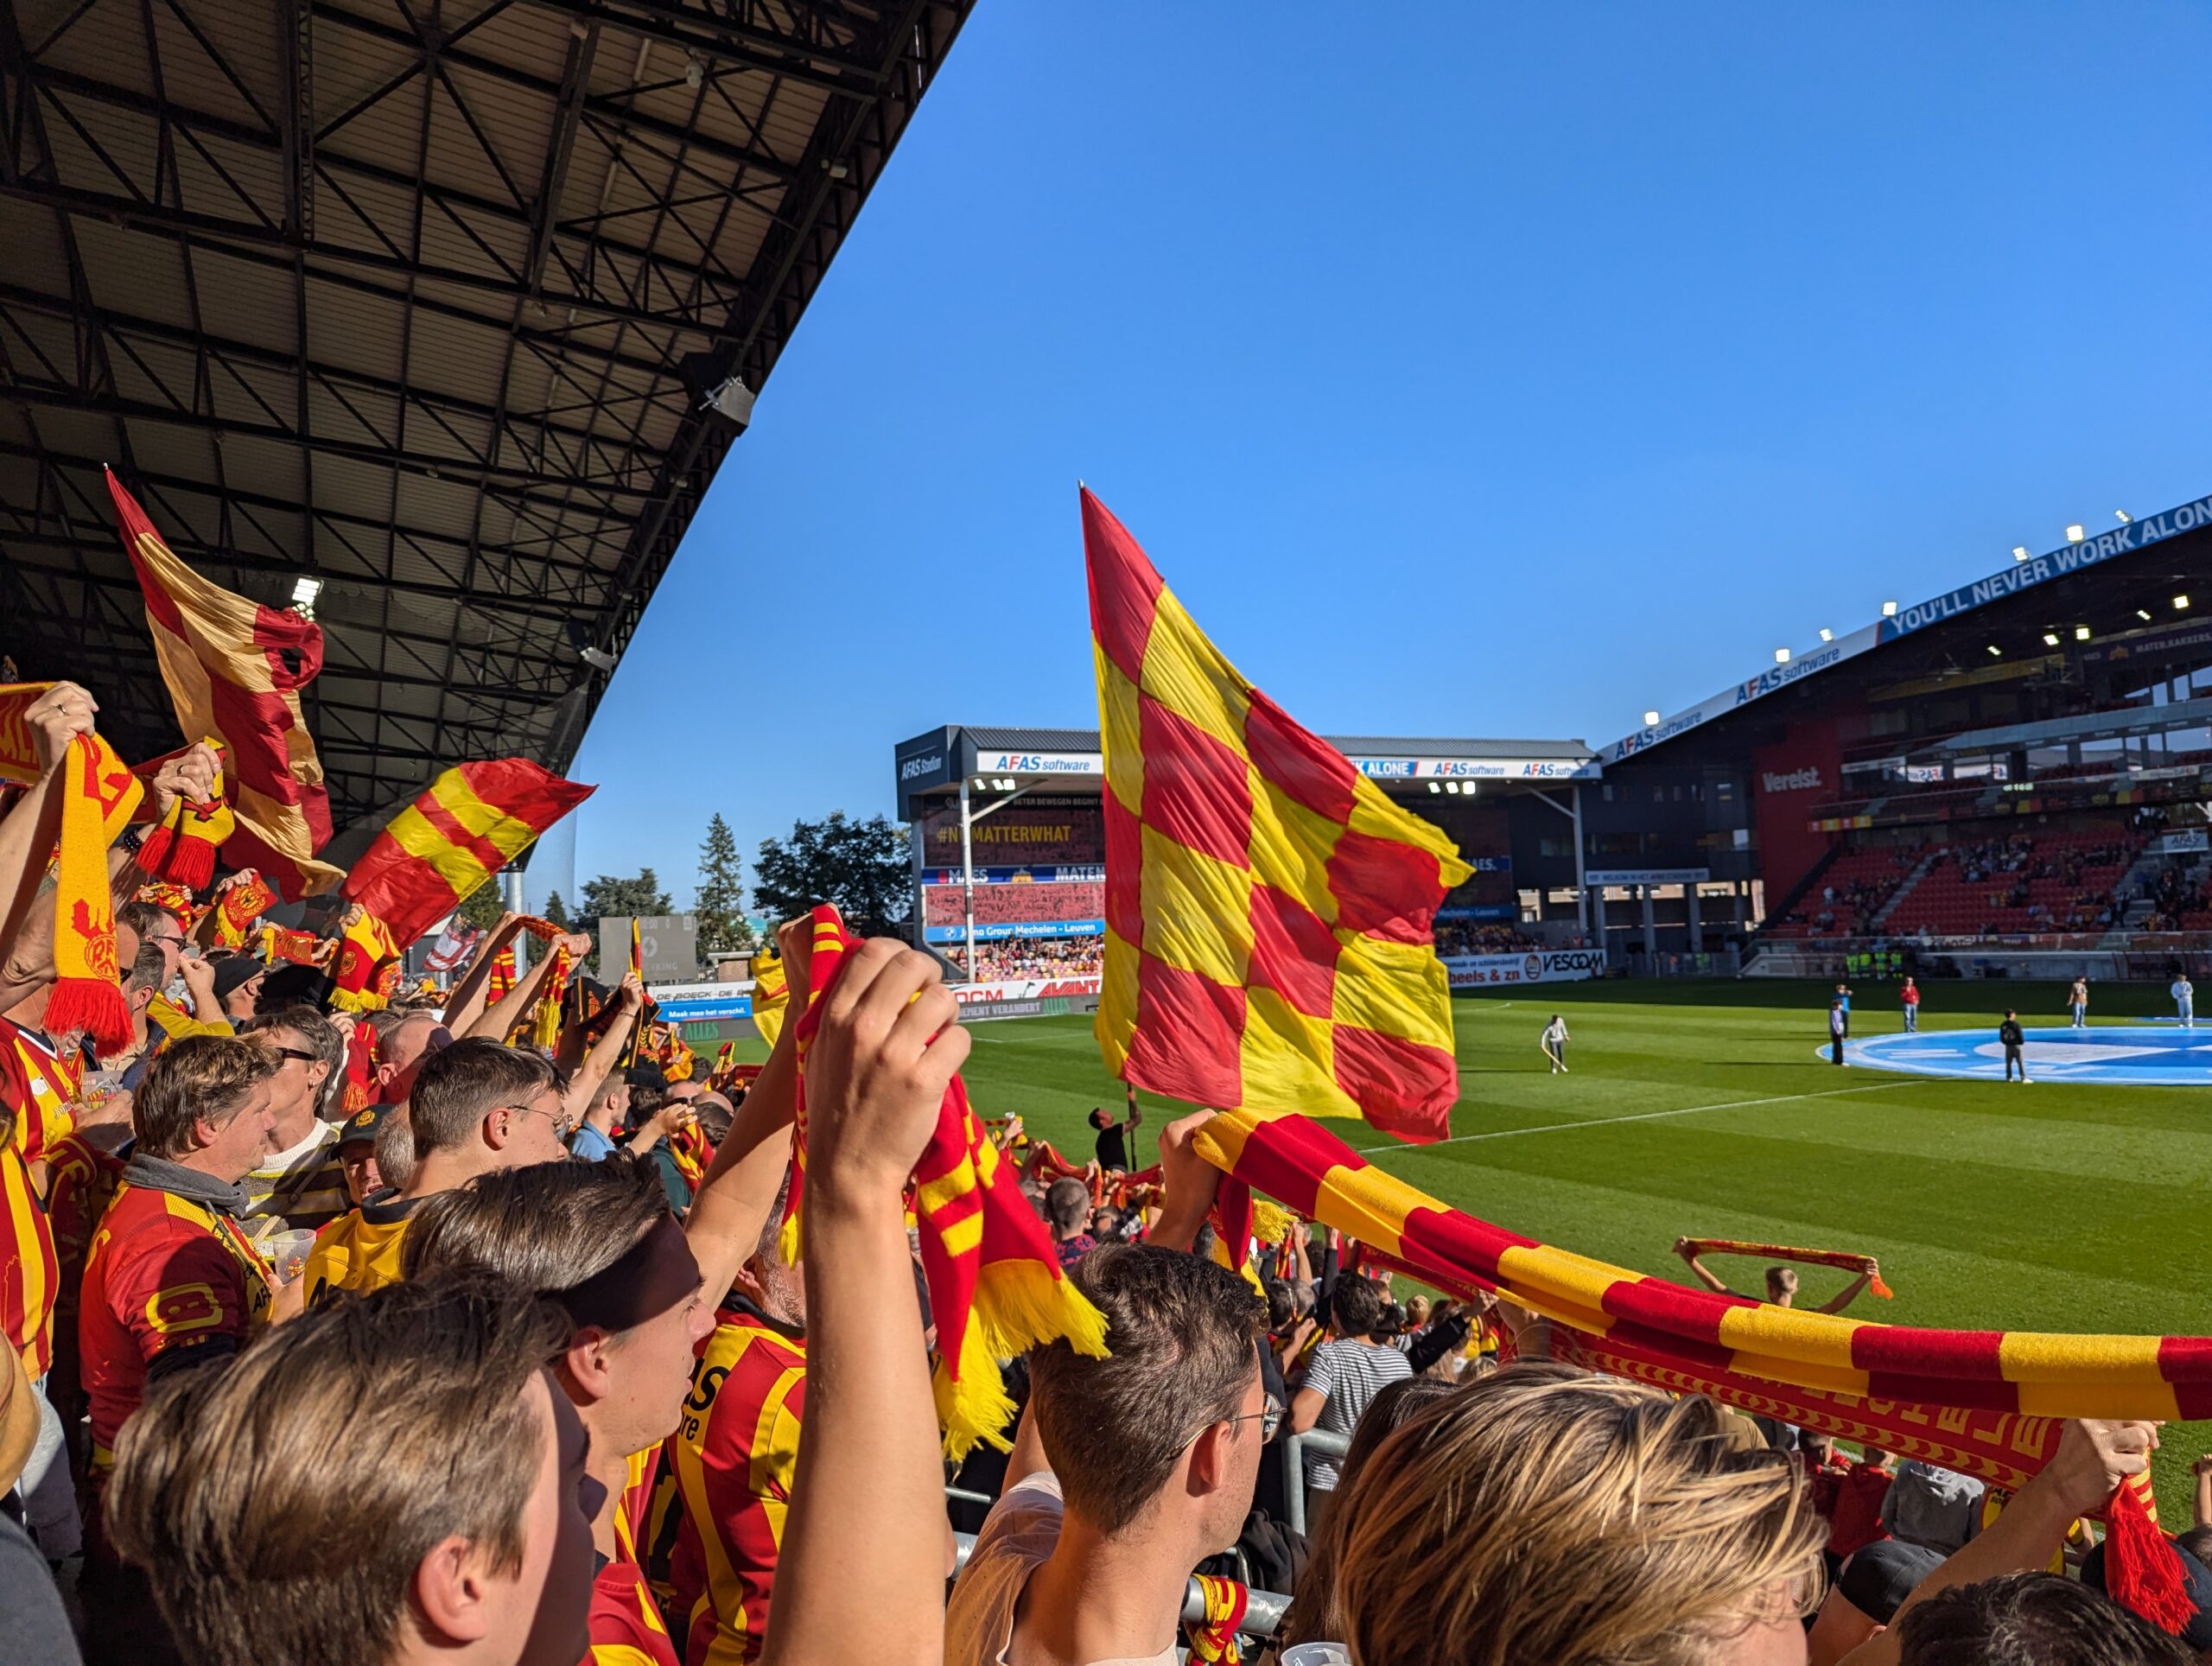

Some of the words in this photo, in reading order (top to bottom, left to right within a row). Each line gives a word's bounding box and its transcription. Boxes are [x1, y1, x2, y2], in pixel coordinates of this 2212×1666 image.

[1891, 593, 1968, 634] YOU'LL
[1972, 559, 2050, 604] NEVER
[2054, 527, 2134, 571] WORK
[1735, 667, 1782, 704] AFAS
[1783, 648, 1840, 682] software
[1616, 728, 1653, 760] AFAS
[1656, 711, 1701, 741] software
[901, 760, 920, 780] AFAS
[921, 756, 942, 774] Stadion
[996, 755, 1041, 771] AFAS
[1042, 760, 1090, 772] software
[1367, 761, 1410, 775] ALONE
[1433, 762, 1467, 776] AFAS
[1468, 765, 1504, 776] software
[1522, 763, 1554, 776] AFAS
[938, 825, 1071, 843] #NMATTERWHAT
[1015, 925, 1057, 935] Mechelen
[1065, 924, 1096, 932] Leuven
[1542, 952, 1604, 972] VESCOM
[1490, 969, 1500, 982] &
[1504, 970, 1520, 982] zn
[676, 991, 712, 1000] BOECK
[669, 1009, 688, 1018] Maak
[993, 1002, 1040, 1014] VERANDERT
[1043, 997, 1071, 1014] ALLES
[686, 1022, 719, 1040] ALLES
